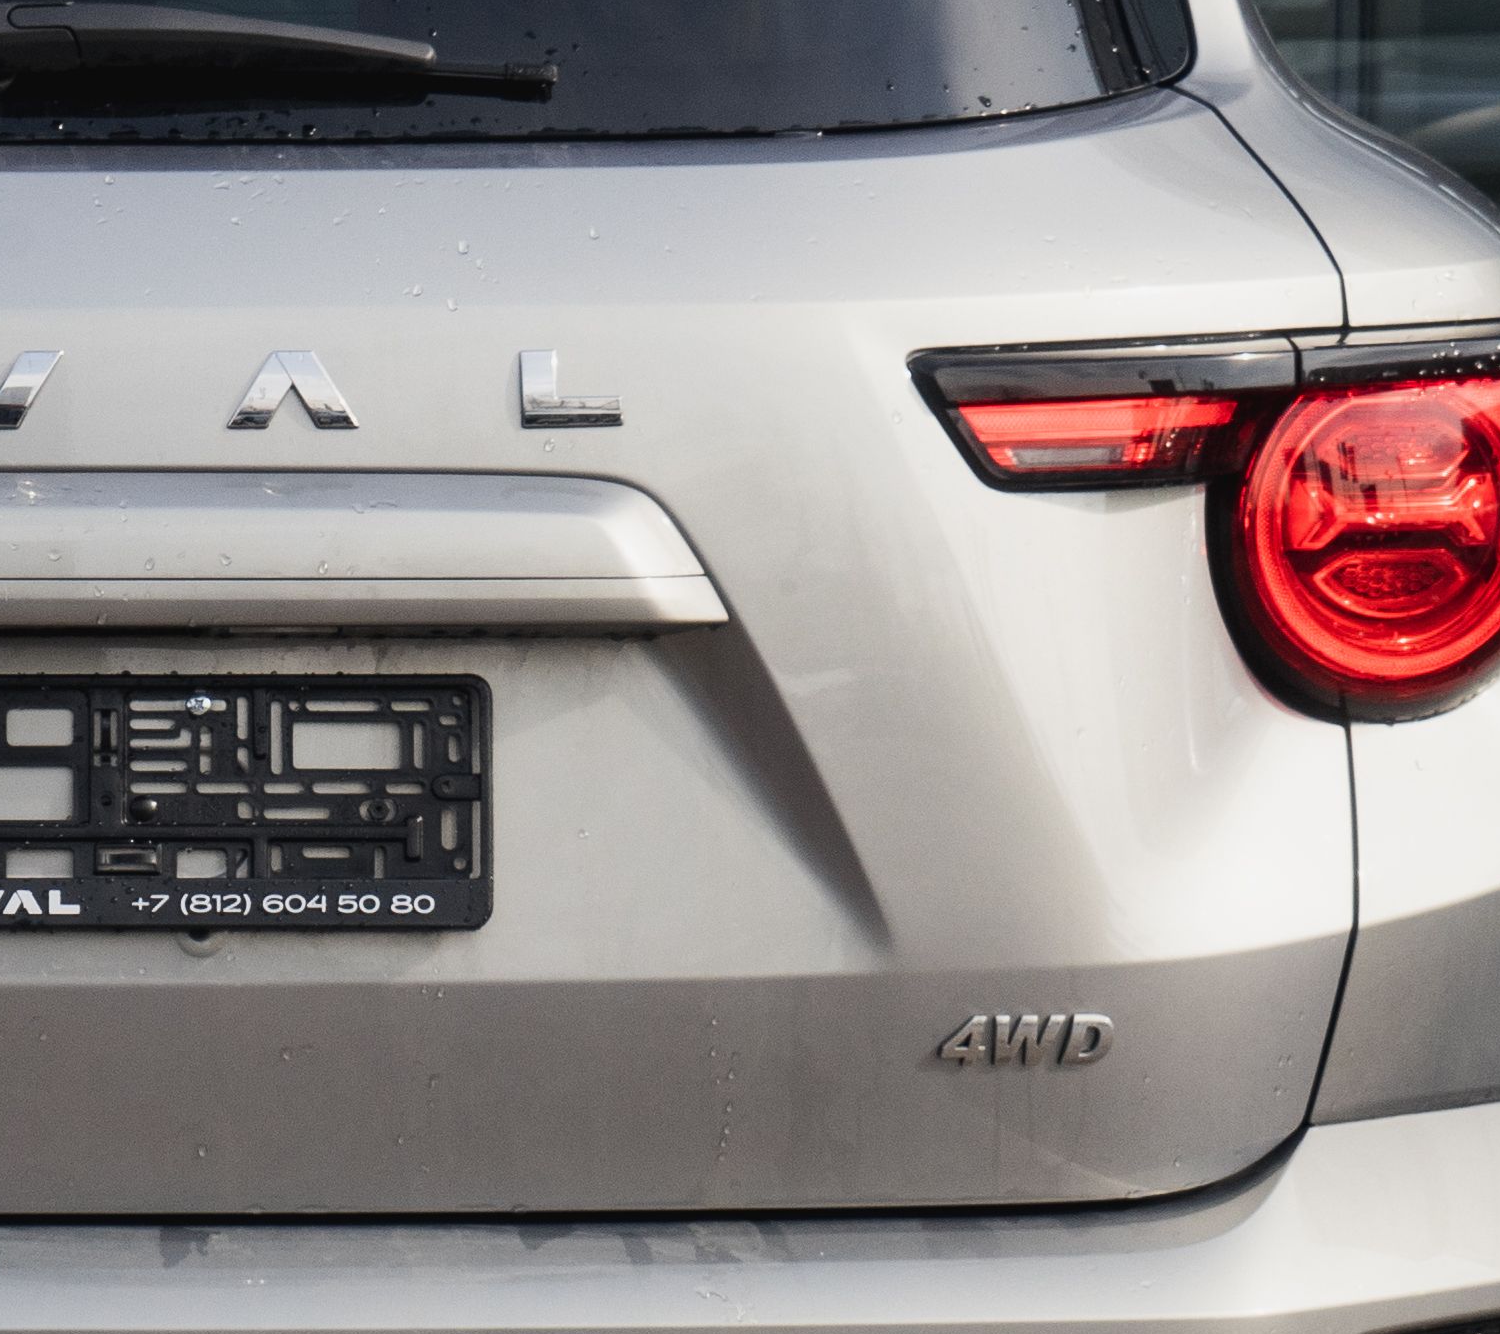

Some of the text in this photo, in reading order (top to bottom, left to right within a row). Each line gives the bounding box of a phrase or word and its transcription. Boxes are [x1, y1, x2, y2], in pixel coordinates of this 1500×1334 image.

[131, 893, 436, 916] +7 (812) 604 50 80
[937, 1014, 1114, 1069] 4WD
